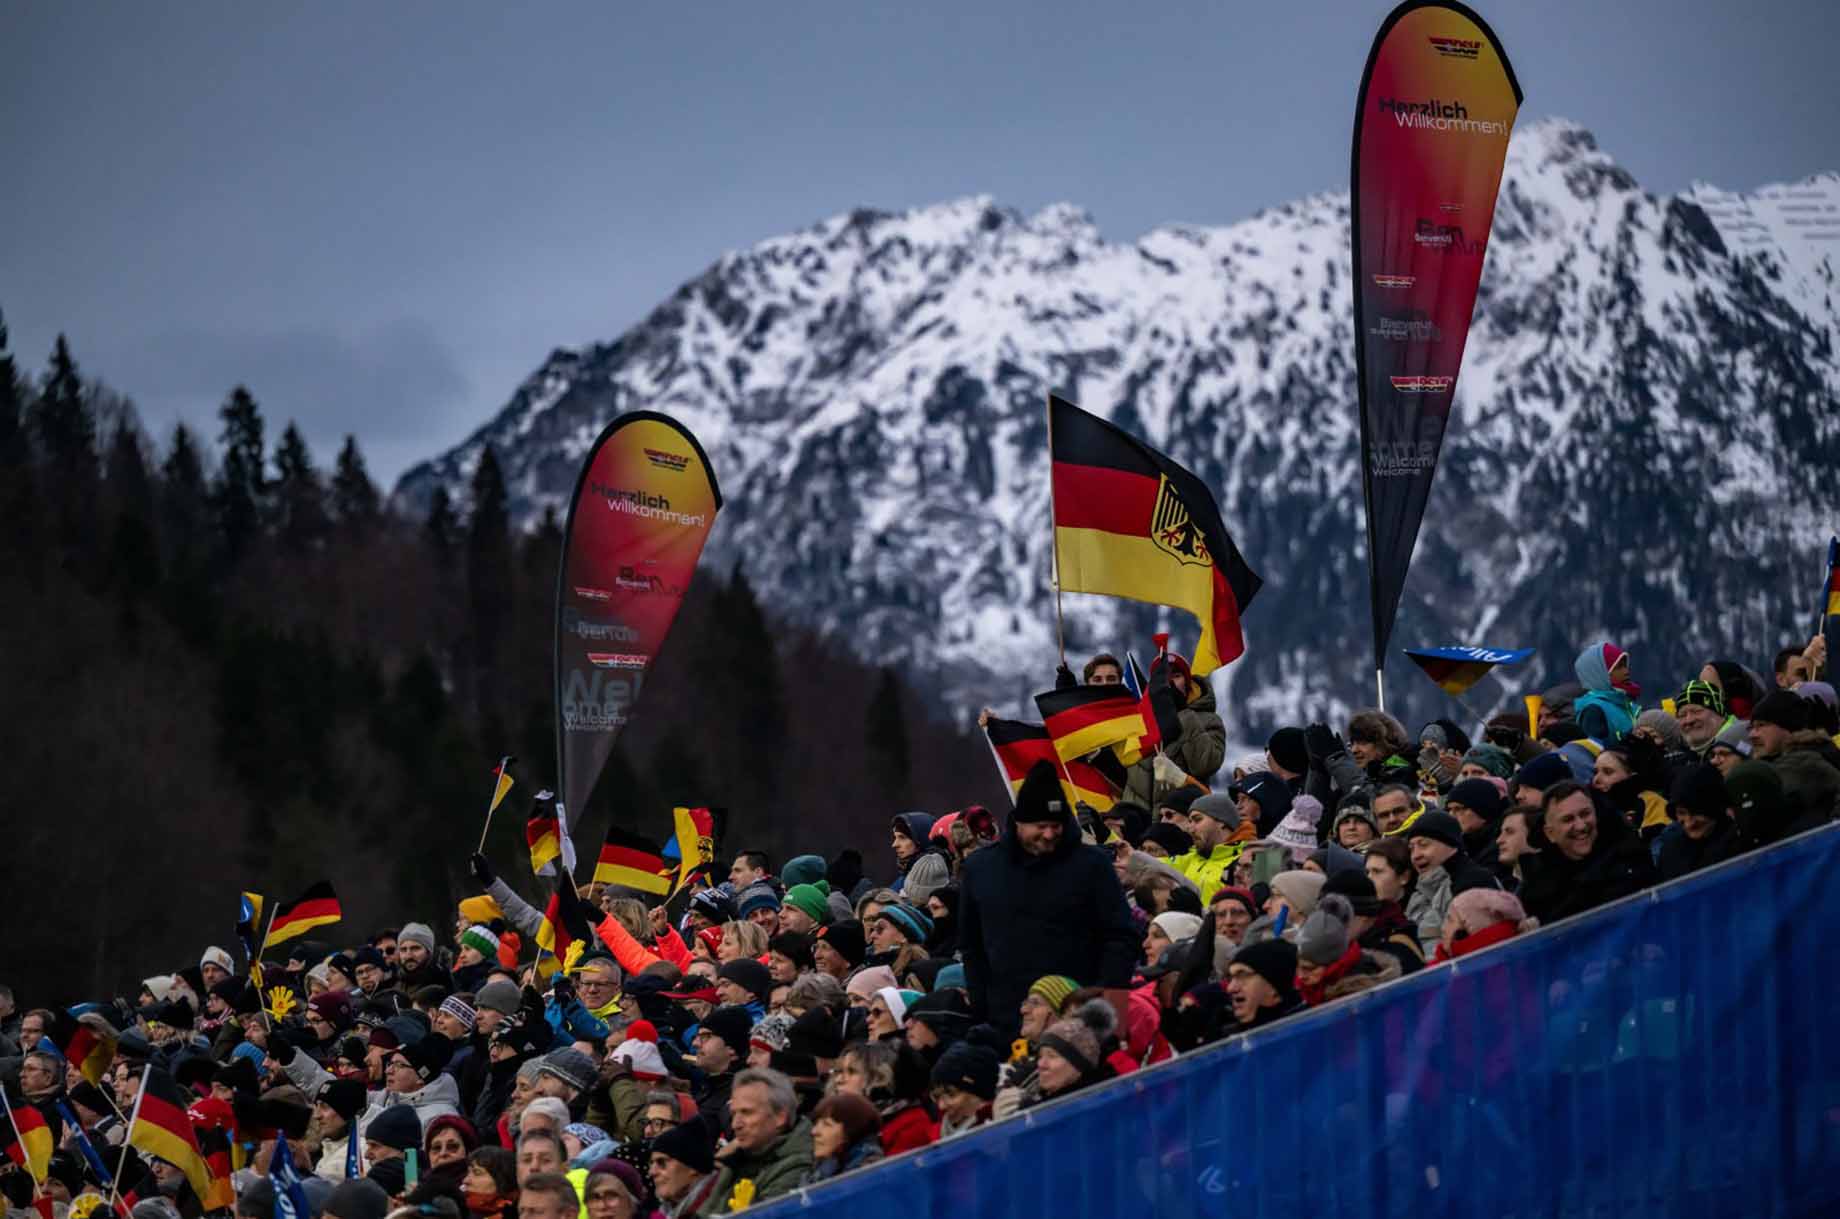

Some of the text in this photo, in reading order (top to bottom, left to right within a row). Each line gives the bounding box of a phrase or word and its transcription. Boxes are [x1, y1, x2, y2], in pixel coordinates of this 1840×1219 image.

[1377, 96, 1468, 119] Herzlich
[1394, 111, 1508, 136] Willkommen!
[591, 481, 671, 511] Herzlich
